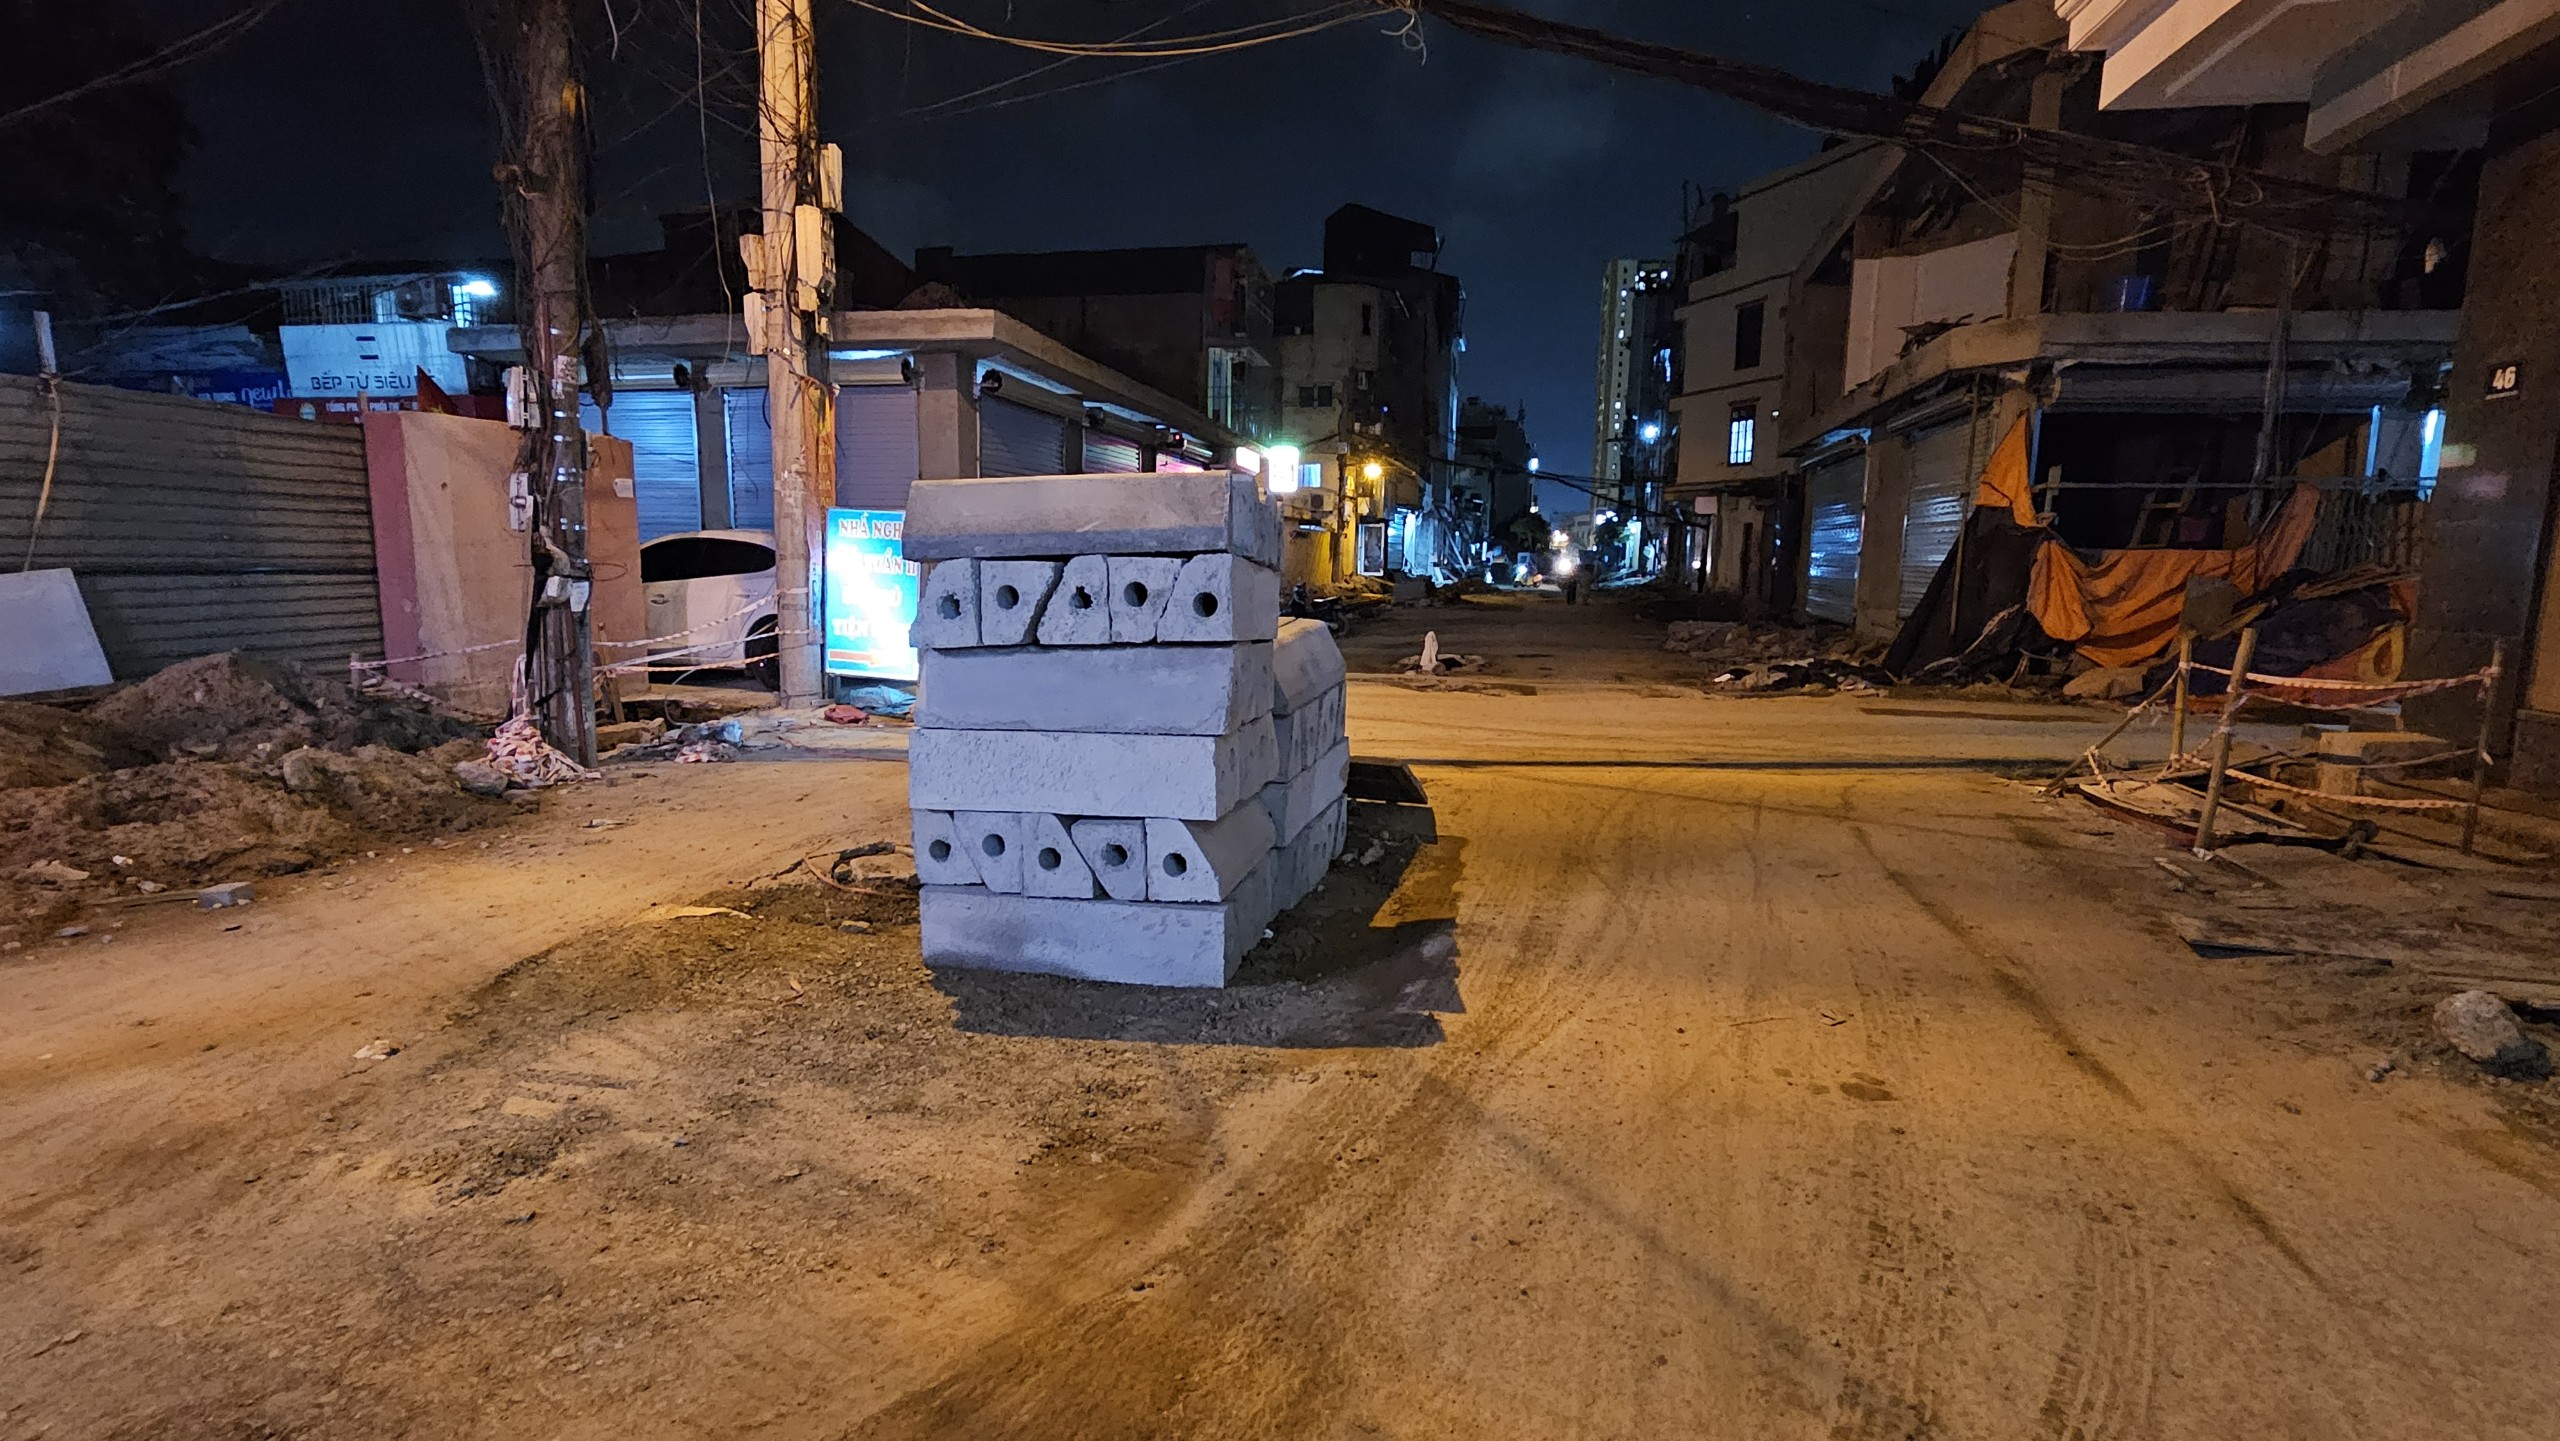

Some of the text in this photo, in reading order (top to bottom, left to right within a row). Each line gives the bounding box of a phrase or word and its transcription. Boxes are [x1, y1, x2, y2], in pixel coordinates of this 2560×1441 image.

[311, 370, 342, 391] BẾP
[374, 371, 411, 390] SIÊU
[2493, 366, 2517, 390] 46
[839, 514, 902, 539] NHÀ NGH
